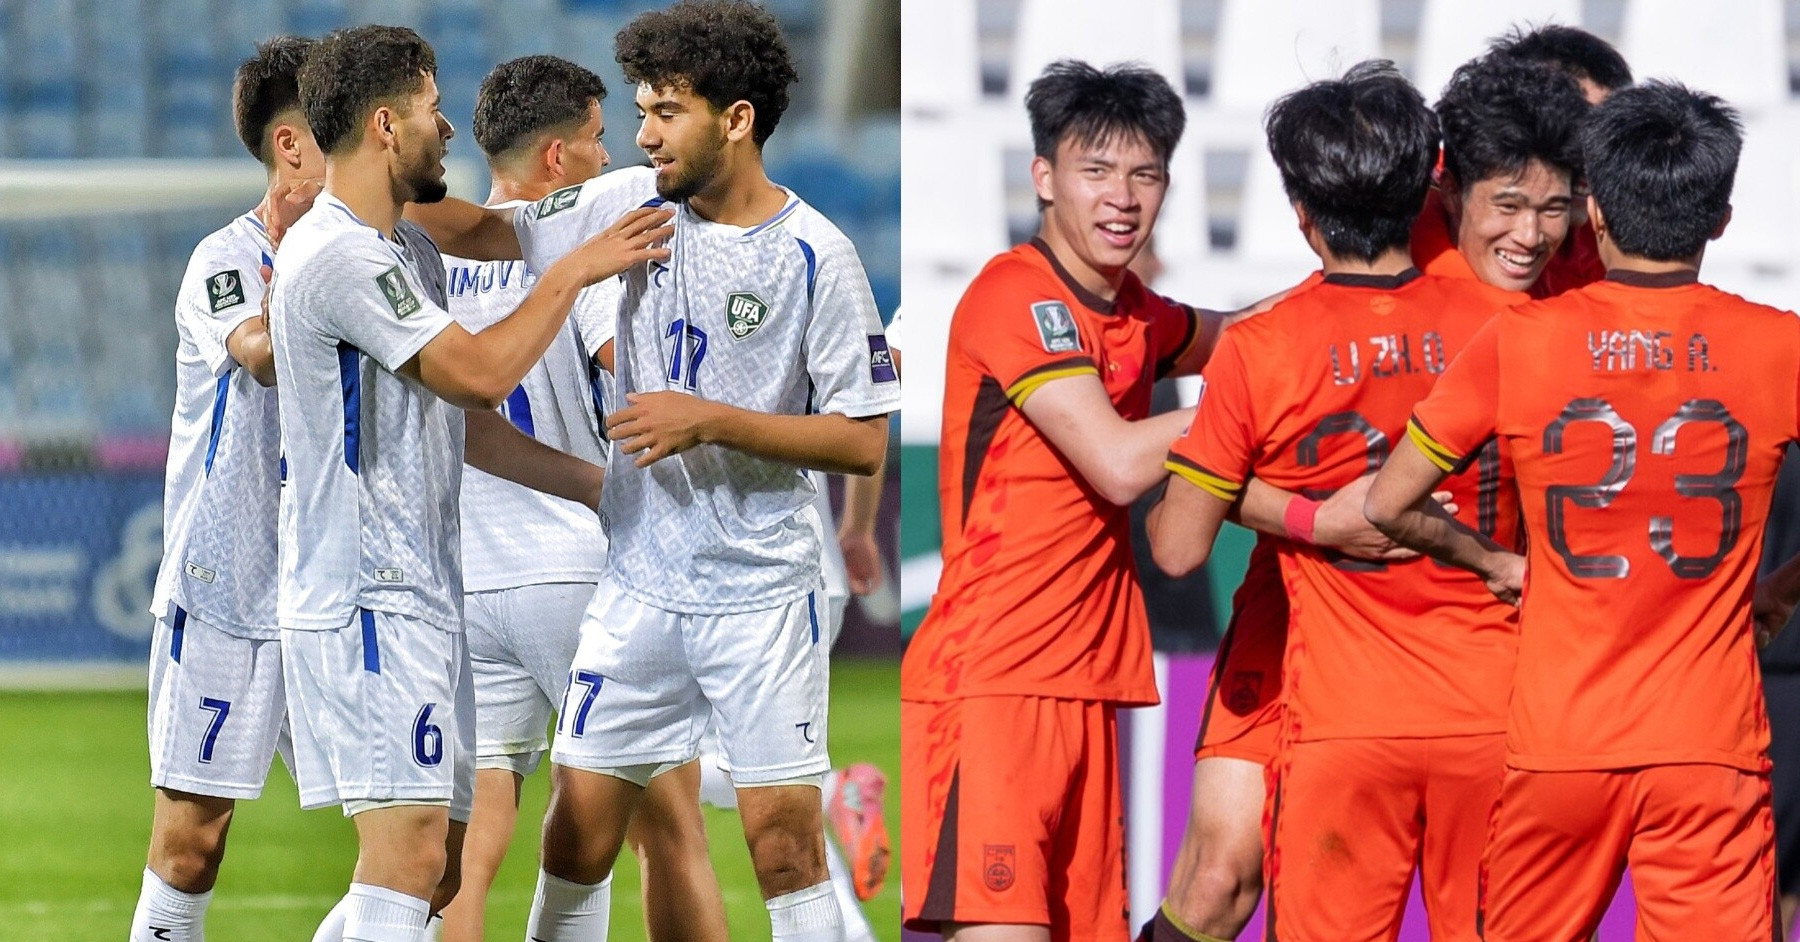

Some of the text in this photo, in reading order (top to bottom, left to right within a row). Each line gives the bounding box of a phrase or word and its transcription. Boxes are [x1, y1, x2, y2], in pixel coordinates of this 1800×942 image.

[731, 298, 760, 323] UFA
[665, 318, 707, 392] 17
[871, 350, 889, 364] AFC
[1588, 330, 1718, 372] YANG A.
[1543, 397, 1749, 580] 23
[199, 696, 231, 765] 7
[411, 702, 443, 768] 6
[557, 669, 604, 739] 17
